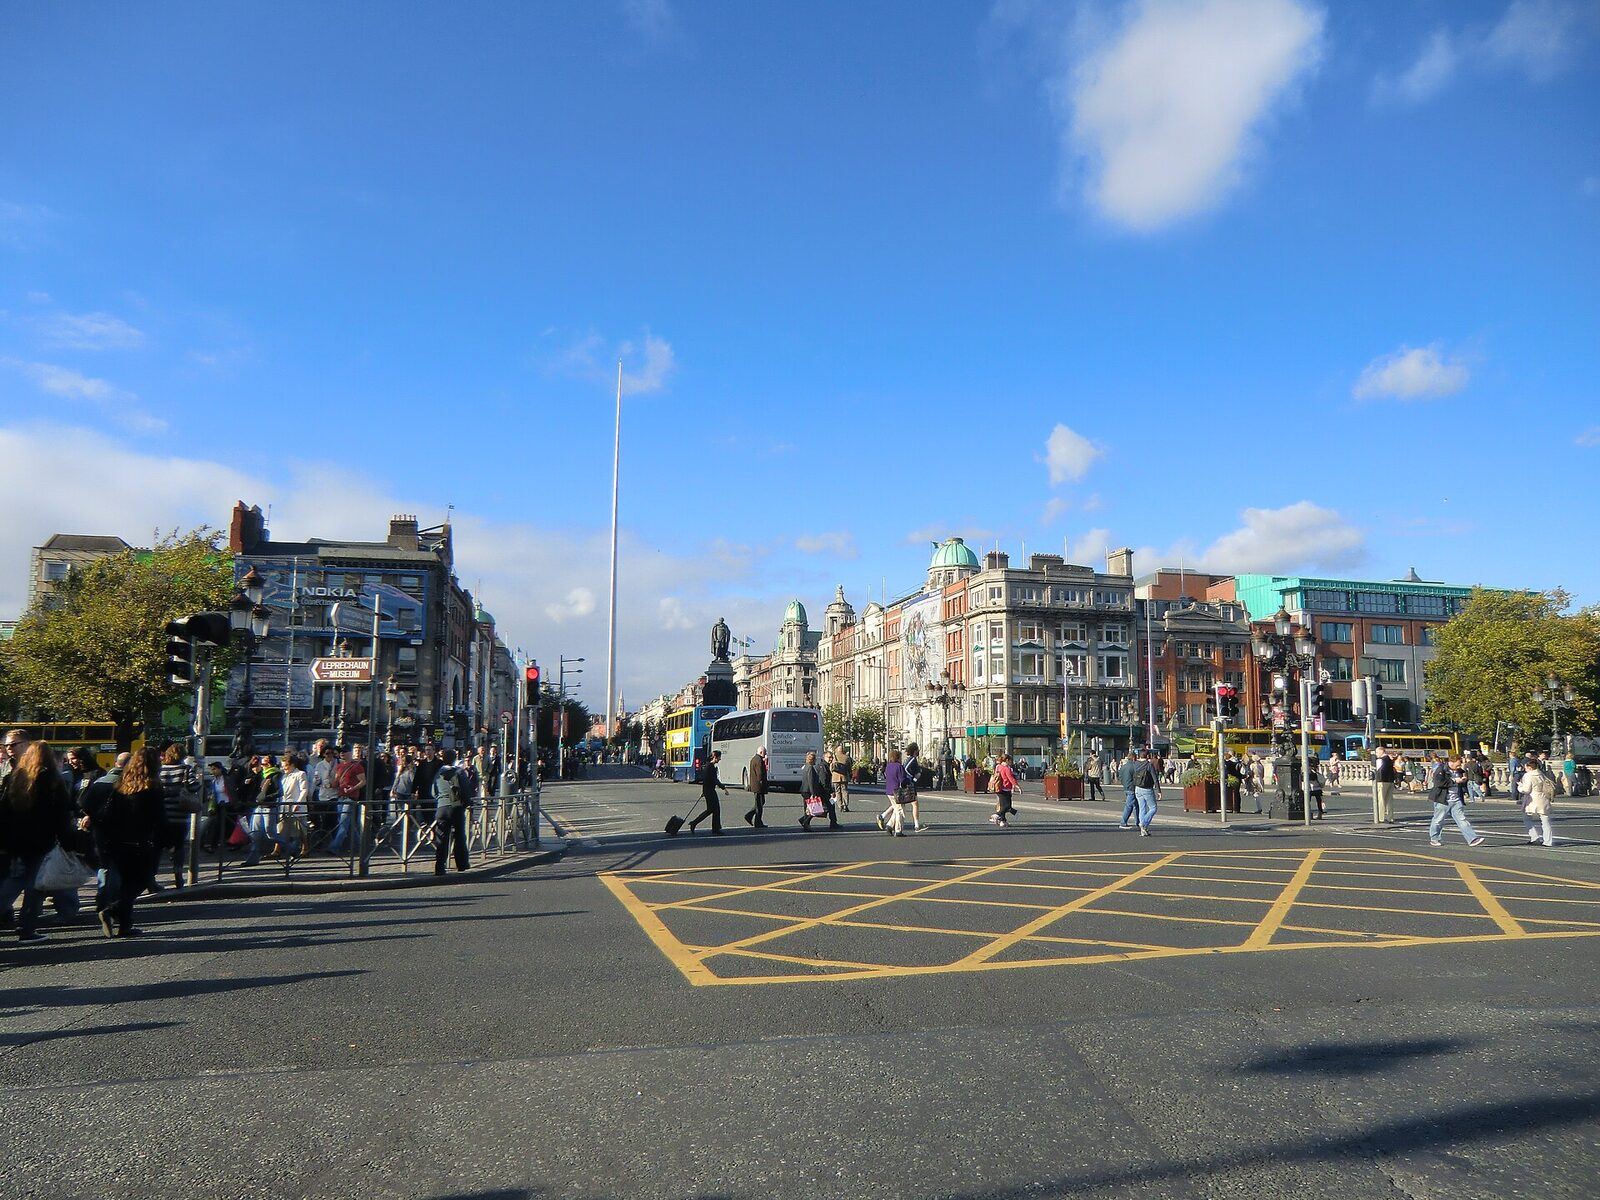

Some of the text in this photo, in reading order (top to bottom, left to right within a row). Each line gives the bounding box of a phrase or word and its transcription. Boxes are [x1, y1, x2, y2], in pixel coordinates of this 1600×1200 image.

[302, 586, 357, 597] NOKIA
[321, 661, 369, 670] LEPRECHAUN
[329, 670, 361, 678] MUSEUM
